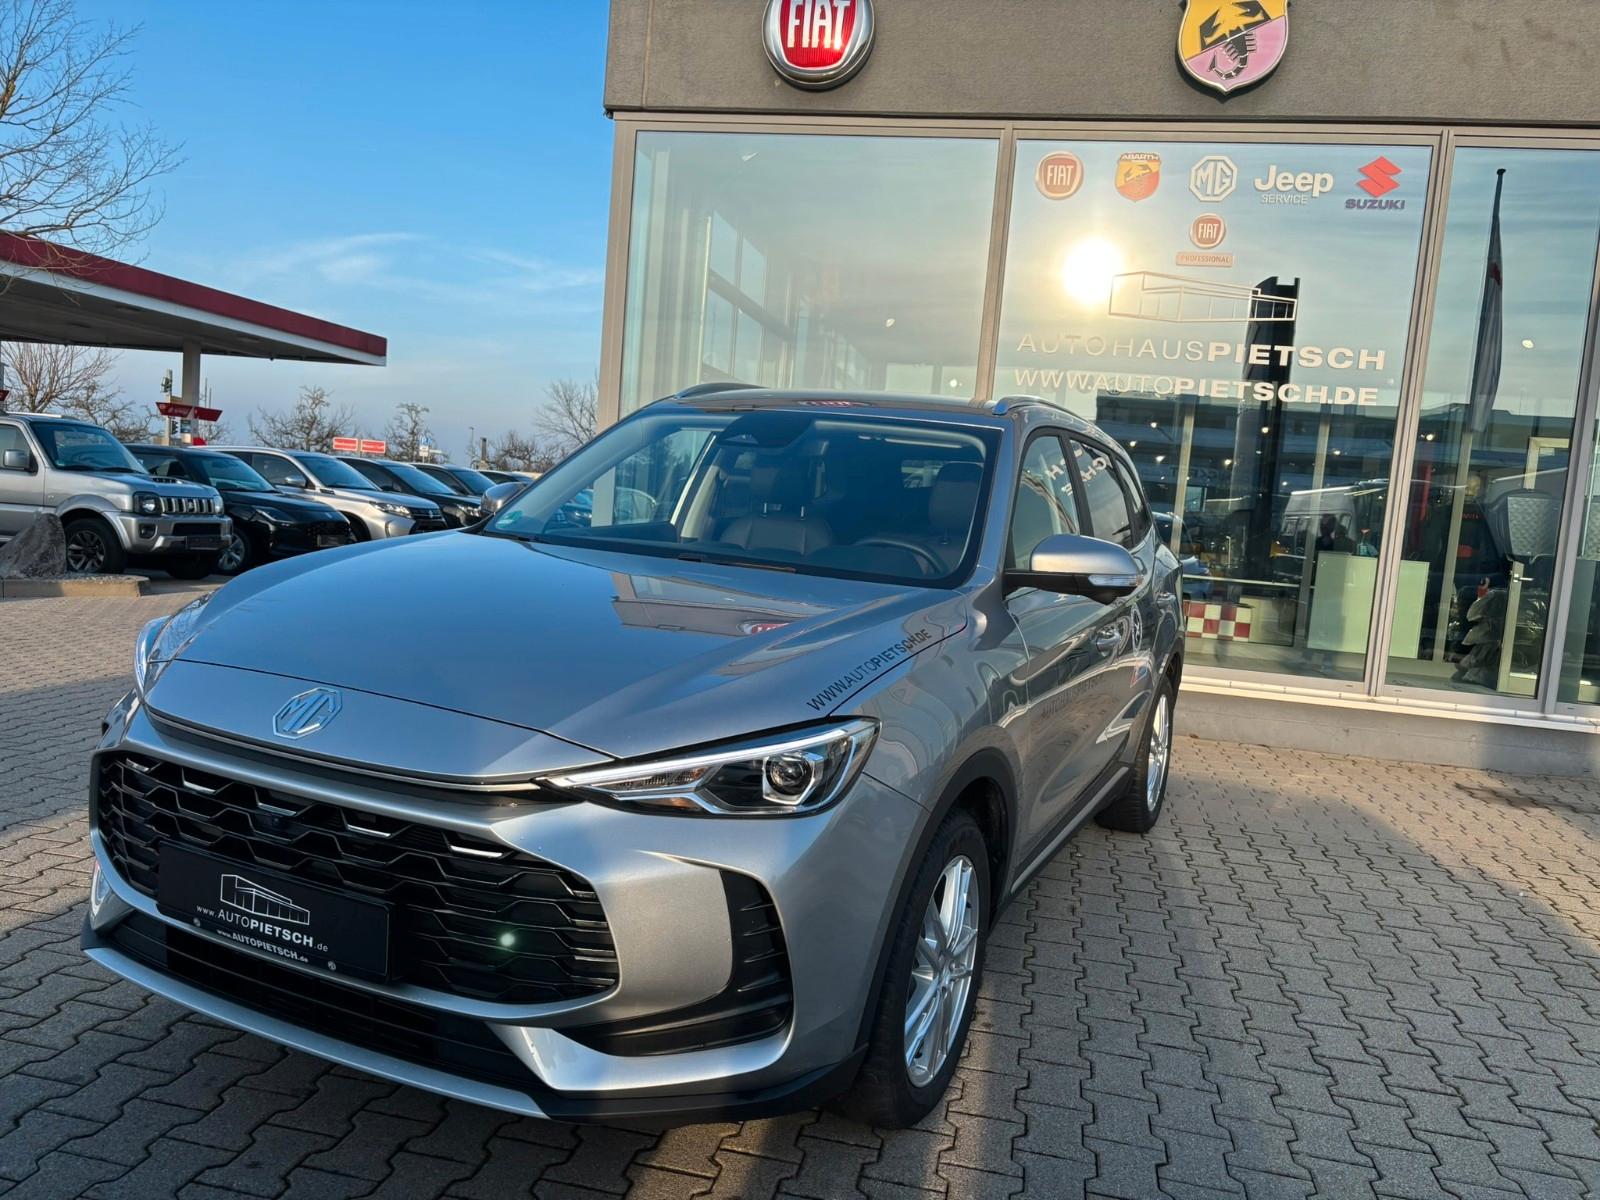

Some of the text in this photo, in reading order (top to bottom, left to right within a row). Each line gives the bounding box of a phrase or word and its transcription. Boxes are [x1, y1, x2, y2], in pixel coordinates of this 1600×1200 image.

[787, 0, 850, 50] FIAT
[1046, 164, 1075, 186] FIAT
[1194, 160, 1235, 197] MG
[1254, 164, 1334, 198] Jeep
[1261, 194, 1308, 205] SERVICE
[1345, 198, 1405, 210] SUZUKI
[1198, 223, 1219, 239] FIAT
[1014, 368, 1379, 406] WWW.AUTOPIETSCH.DE
[806, 628, 933, 712] WWW.AUTOPIETSCH.DE
[196, 904, 329, 952] www.AUTOPIETSCH.de
